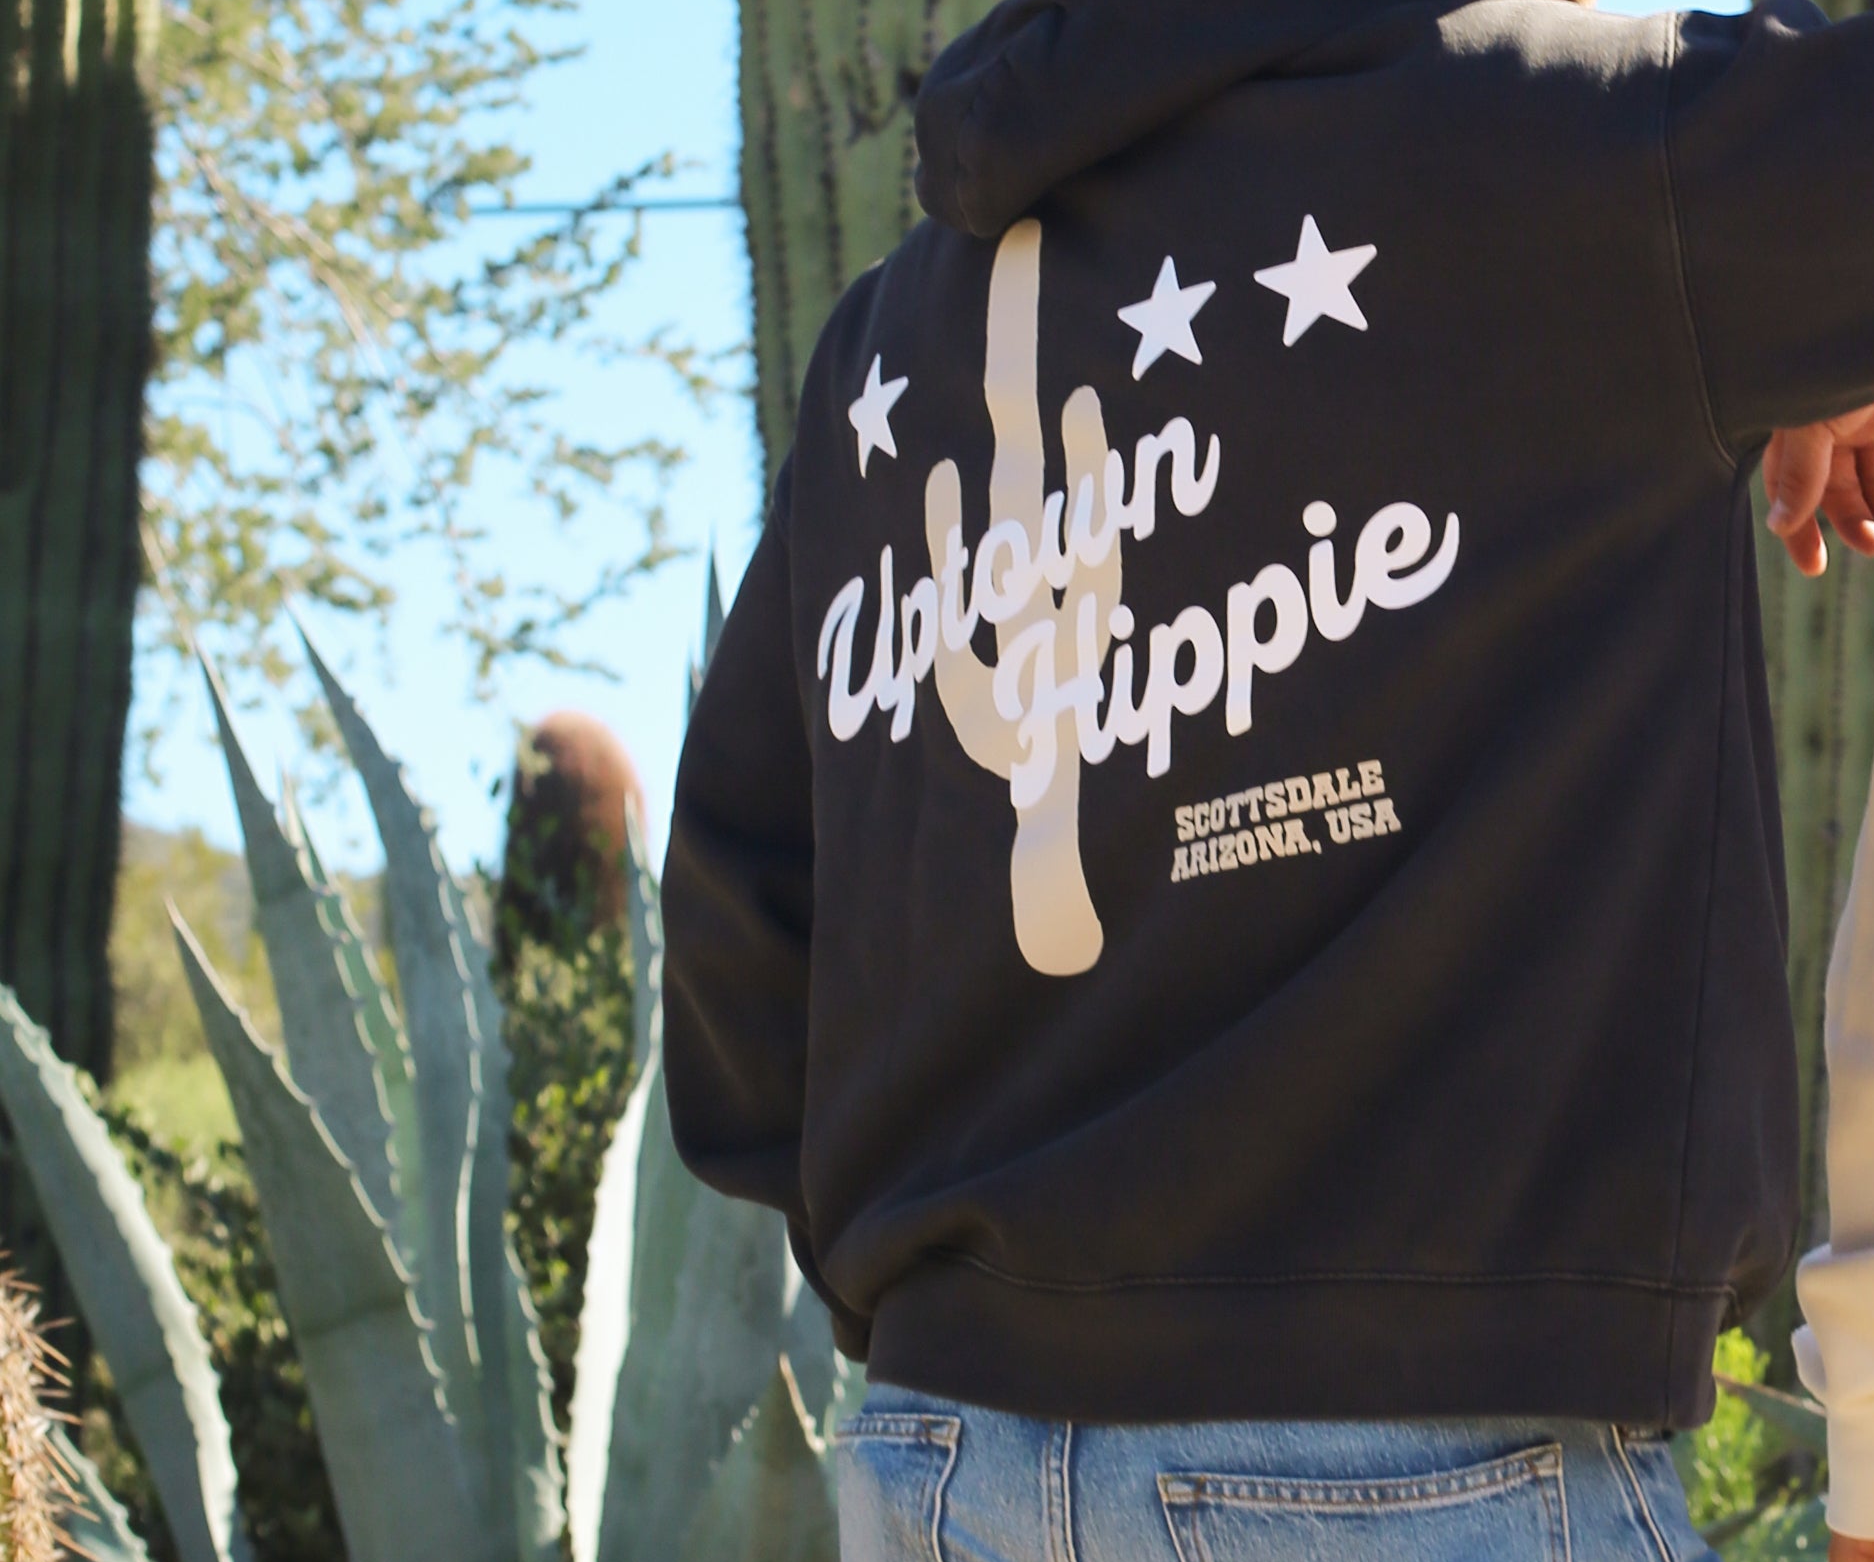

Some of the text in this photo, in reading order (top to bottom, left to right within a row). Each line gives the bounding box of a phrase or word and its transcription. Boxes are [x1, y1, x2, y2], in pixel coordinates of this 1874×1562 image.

[818, 416, 1220, 743] Uptown
[993, 501, 1461, 811] Hippie
[1170, 797, 1402, 884] ARIZONA, USA
[1174, 758, 1386, 843] SCOTTSDALE
